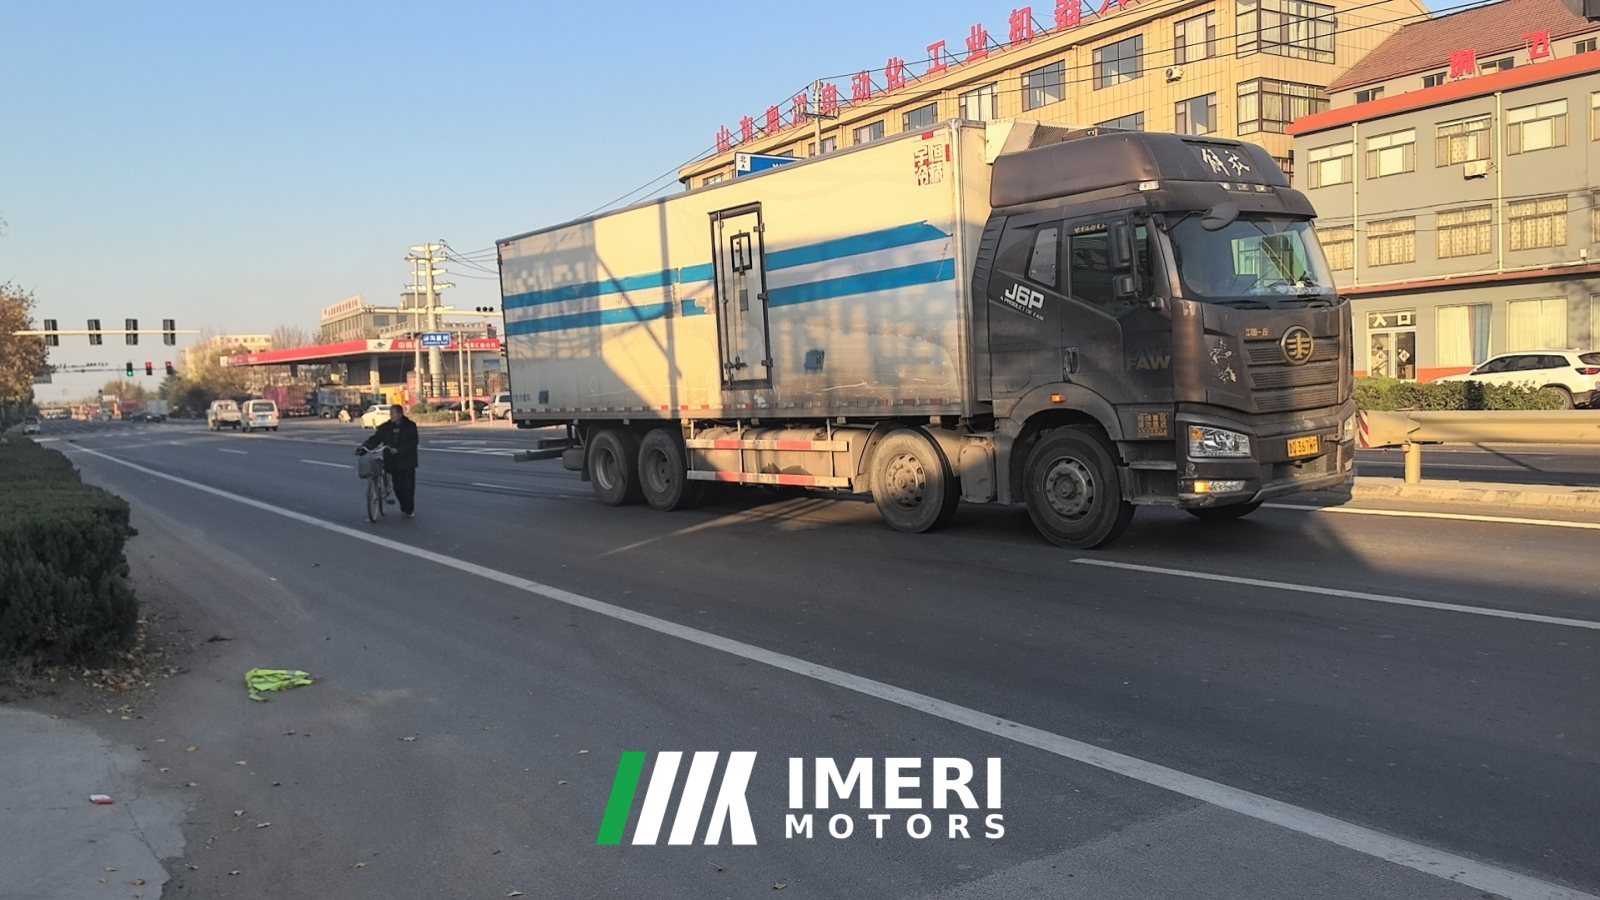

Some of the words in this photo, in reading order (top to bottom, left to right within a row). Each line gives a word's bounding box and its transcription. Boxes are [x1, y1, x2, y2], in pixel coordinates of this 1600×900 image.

[1004, 283, 1045, 309] J6P
[1373, 312, 1411, 328] 入口
[1125, 355, 1171, 370] FAW
